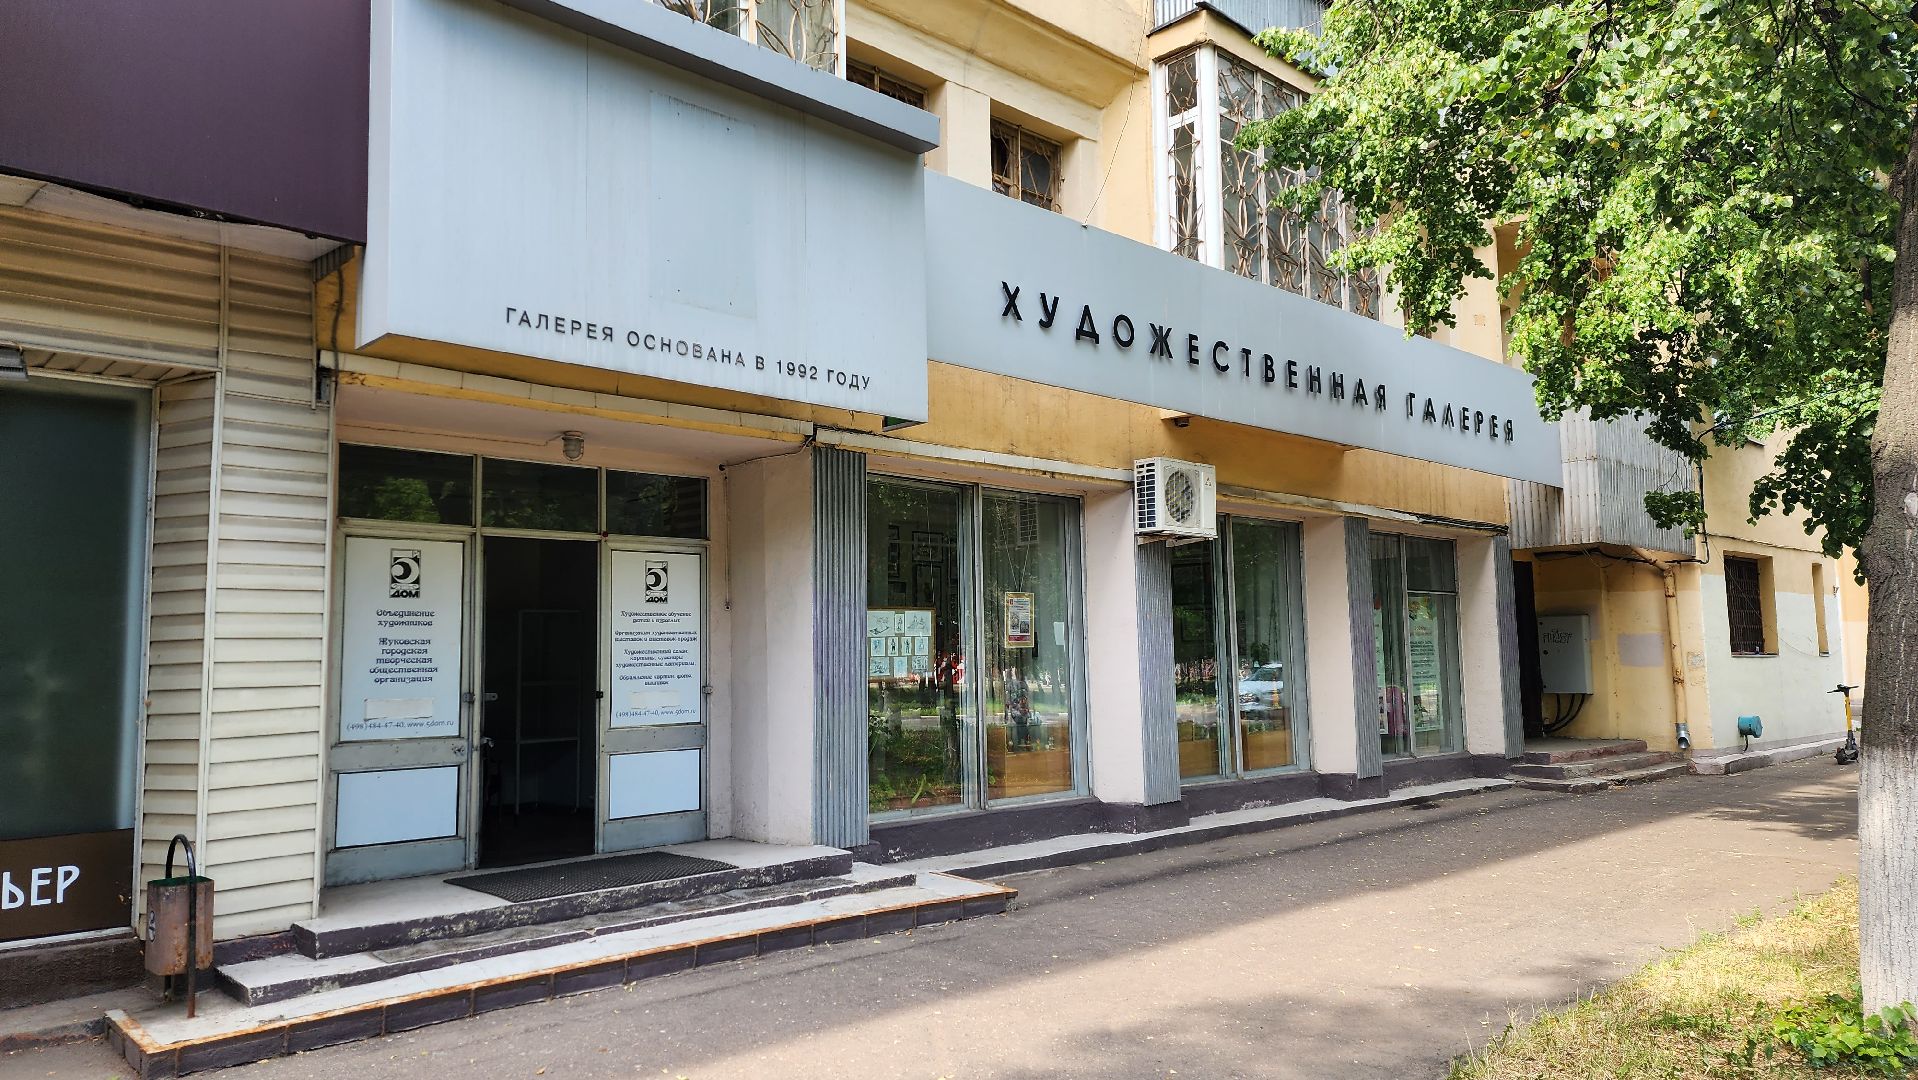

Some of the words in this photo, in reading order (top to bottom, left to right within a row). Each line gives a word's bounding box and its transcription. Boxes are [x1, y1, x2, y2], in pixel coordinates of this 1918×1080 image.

[506, 307, 614, 342] ГАЛЕРЕЯ
[627, 330, 746, 367] ОСНОВАНА
[755, 355, 765, 370] В
[776, 360, 818, 381] 1992
[827, 369, 871, 391] ГОДУ
[1001, 281, 1387, 411] ХУДОЖЕСТВЕННАЯ
[1406, 391, 1514, 441] ГАЛЕРЕЯ
[390, 589, 420, 598] ДОМ
[376, 609, 435, 618] Объединение
[379, 637, 431, 646] Жуковская
[381, 648, 428, 656] городская
[376, 657, 433, 665] творческая
[369, 666, 438, 674] общественная
[374, 676, 433, 684] организация
